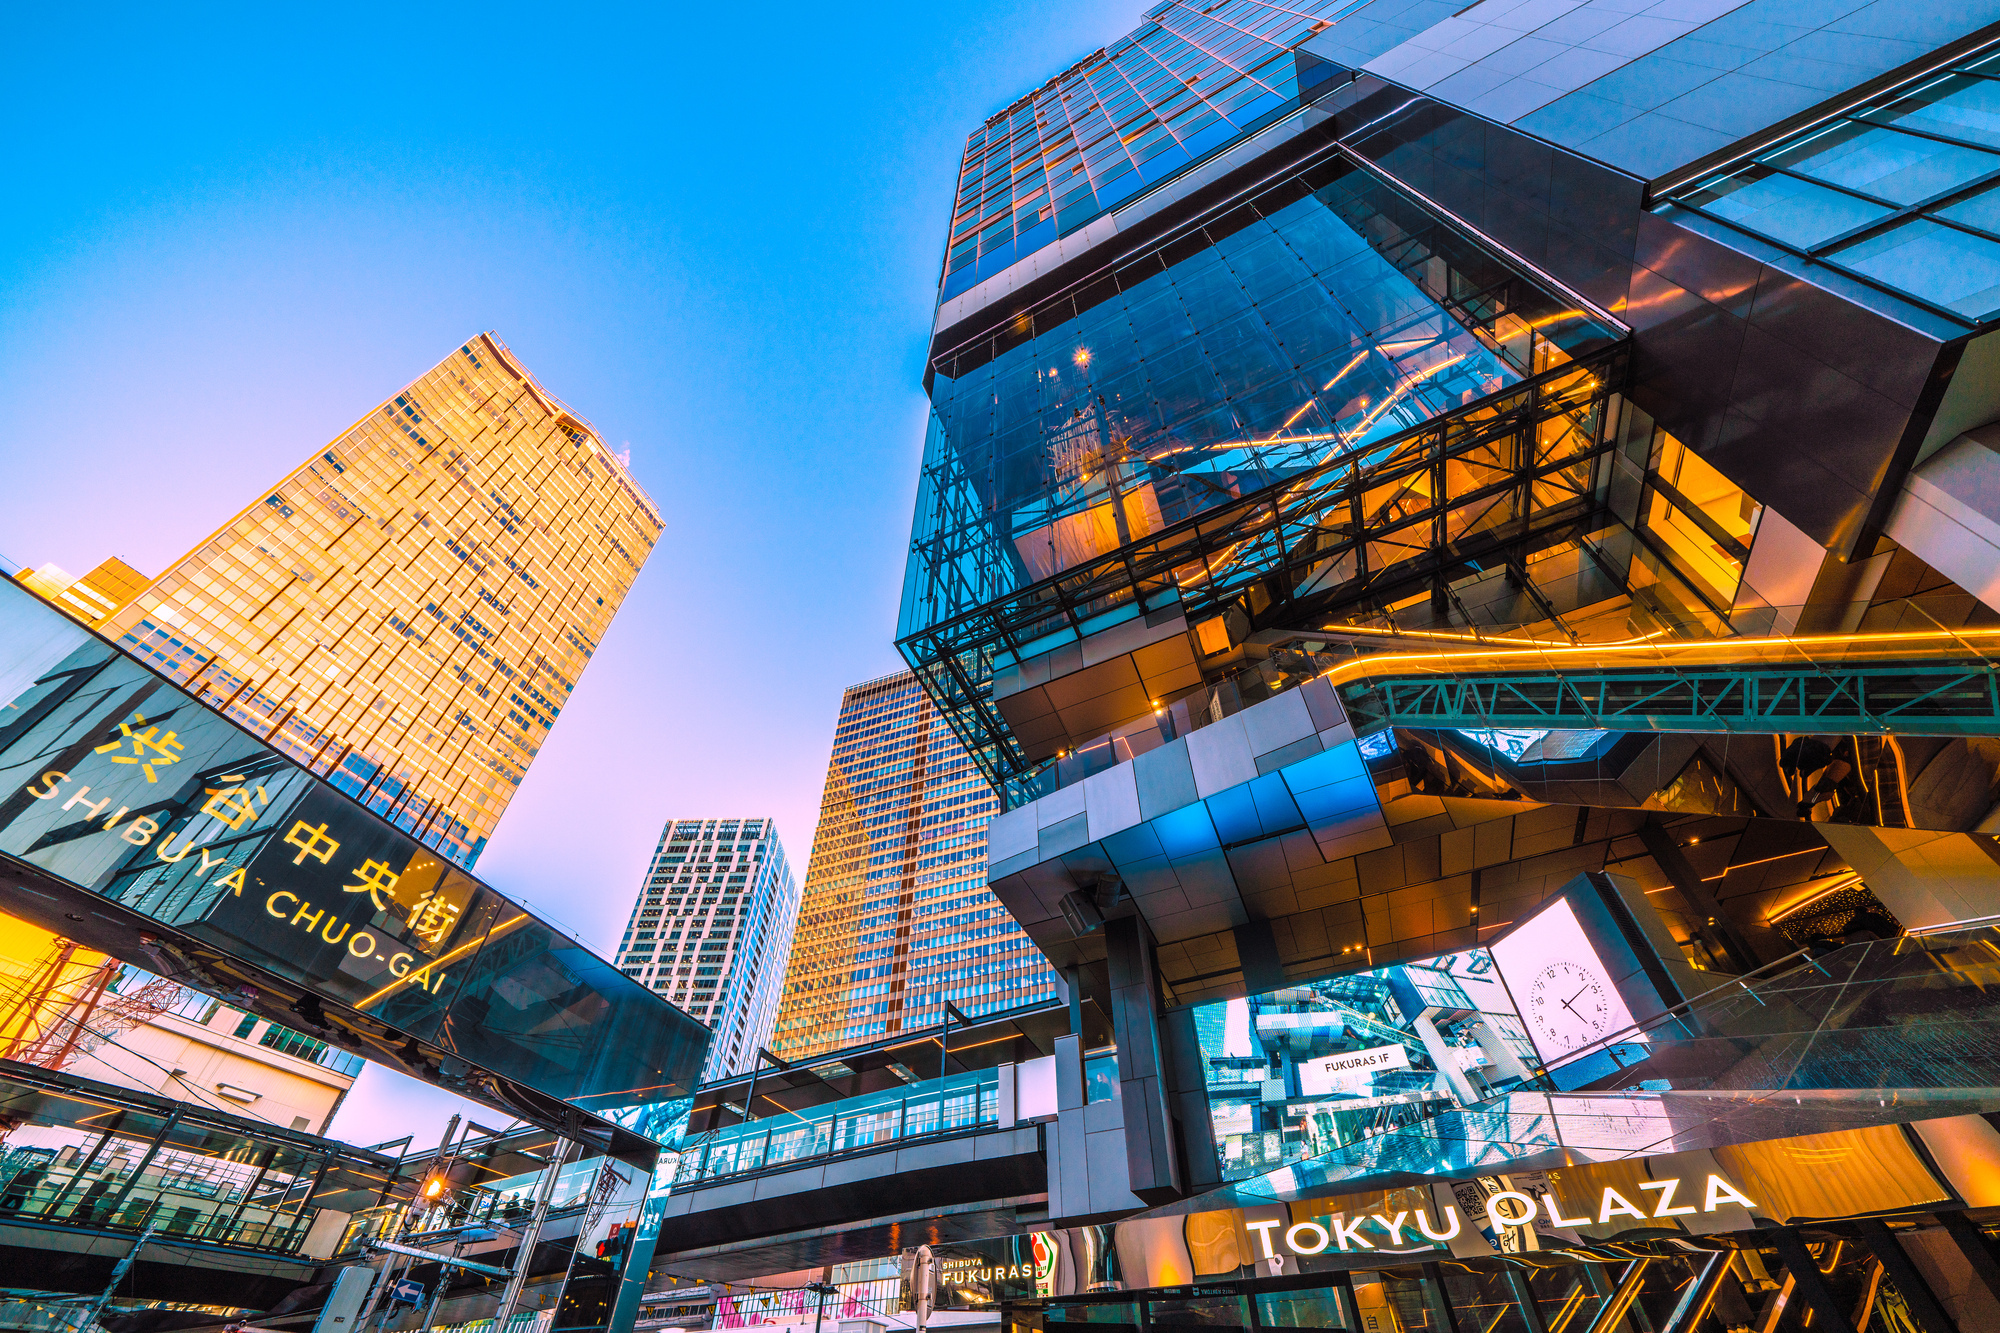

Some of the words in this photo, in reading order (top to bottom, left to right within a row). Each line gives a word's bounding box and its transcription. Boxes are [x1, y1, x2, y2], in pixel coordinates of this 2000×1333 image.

[94, 713, 459, 943] 渋谷中央街
[26, 770, 246, 897] SHIBUYA
[266, 890, 446, 995] CHUO-GAI
[1546, 969, 1557, 979] 12
[1564, 966, 1570, 974] 1
[1578, 972, 1586, 982] 2
[1537, 981, 1546, 991] 11
[1591, 985, 1598, 994] 3
[1535, 996, 1545, 1006] 10
[1596, 1004, 1602, 1012] 4
[1538, 1015, 1544, 1023] 9
[1592, 1020, 1599, 1029] 5
[1549, 1028, 1557, 1037] 8
[1581, 1033, 1588, 1042] 6
[1563, 1035, 1570, 1044] 7
[1325, 1055, 1376, 1073] FUKURAS
[1378, 1053, 1390, 1064] 1F
[1245, 1205, 1462, 1260] TOKYU
[1485, 1173, 1758, 1236] PLAZA
[942, 1258, 982, 1270] SHIBUYA
[942, 1264, 1033, 1286] FUKURAS
